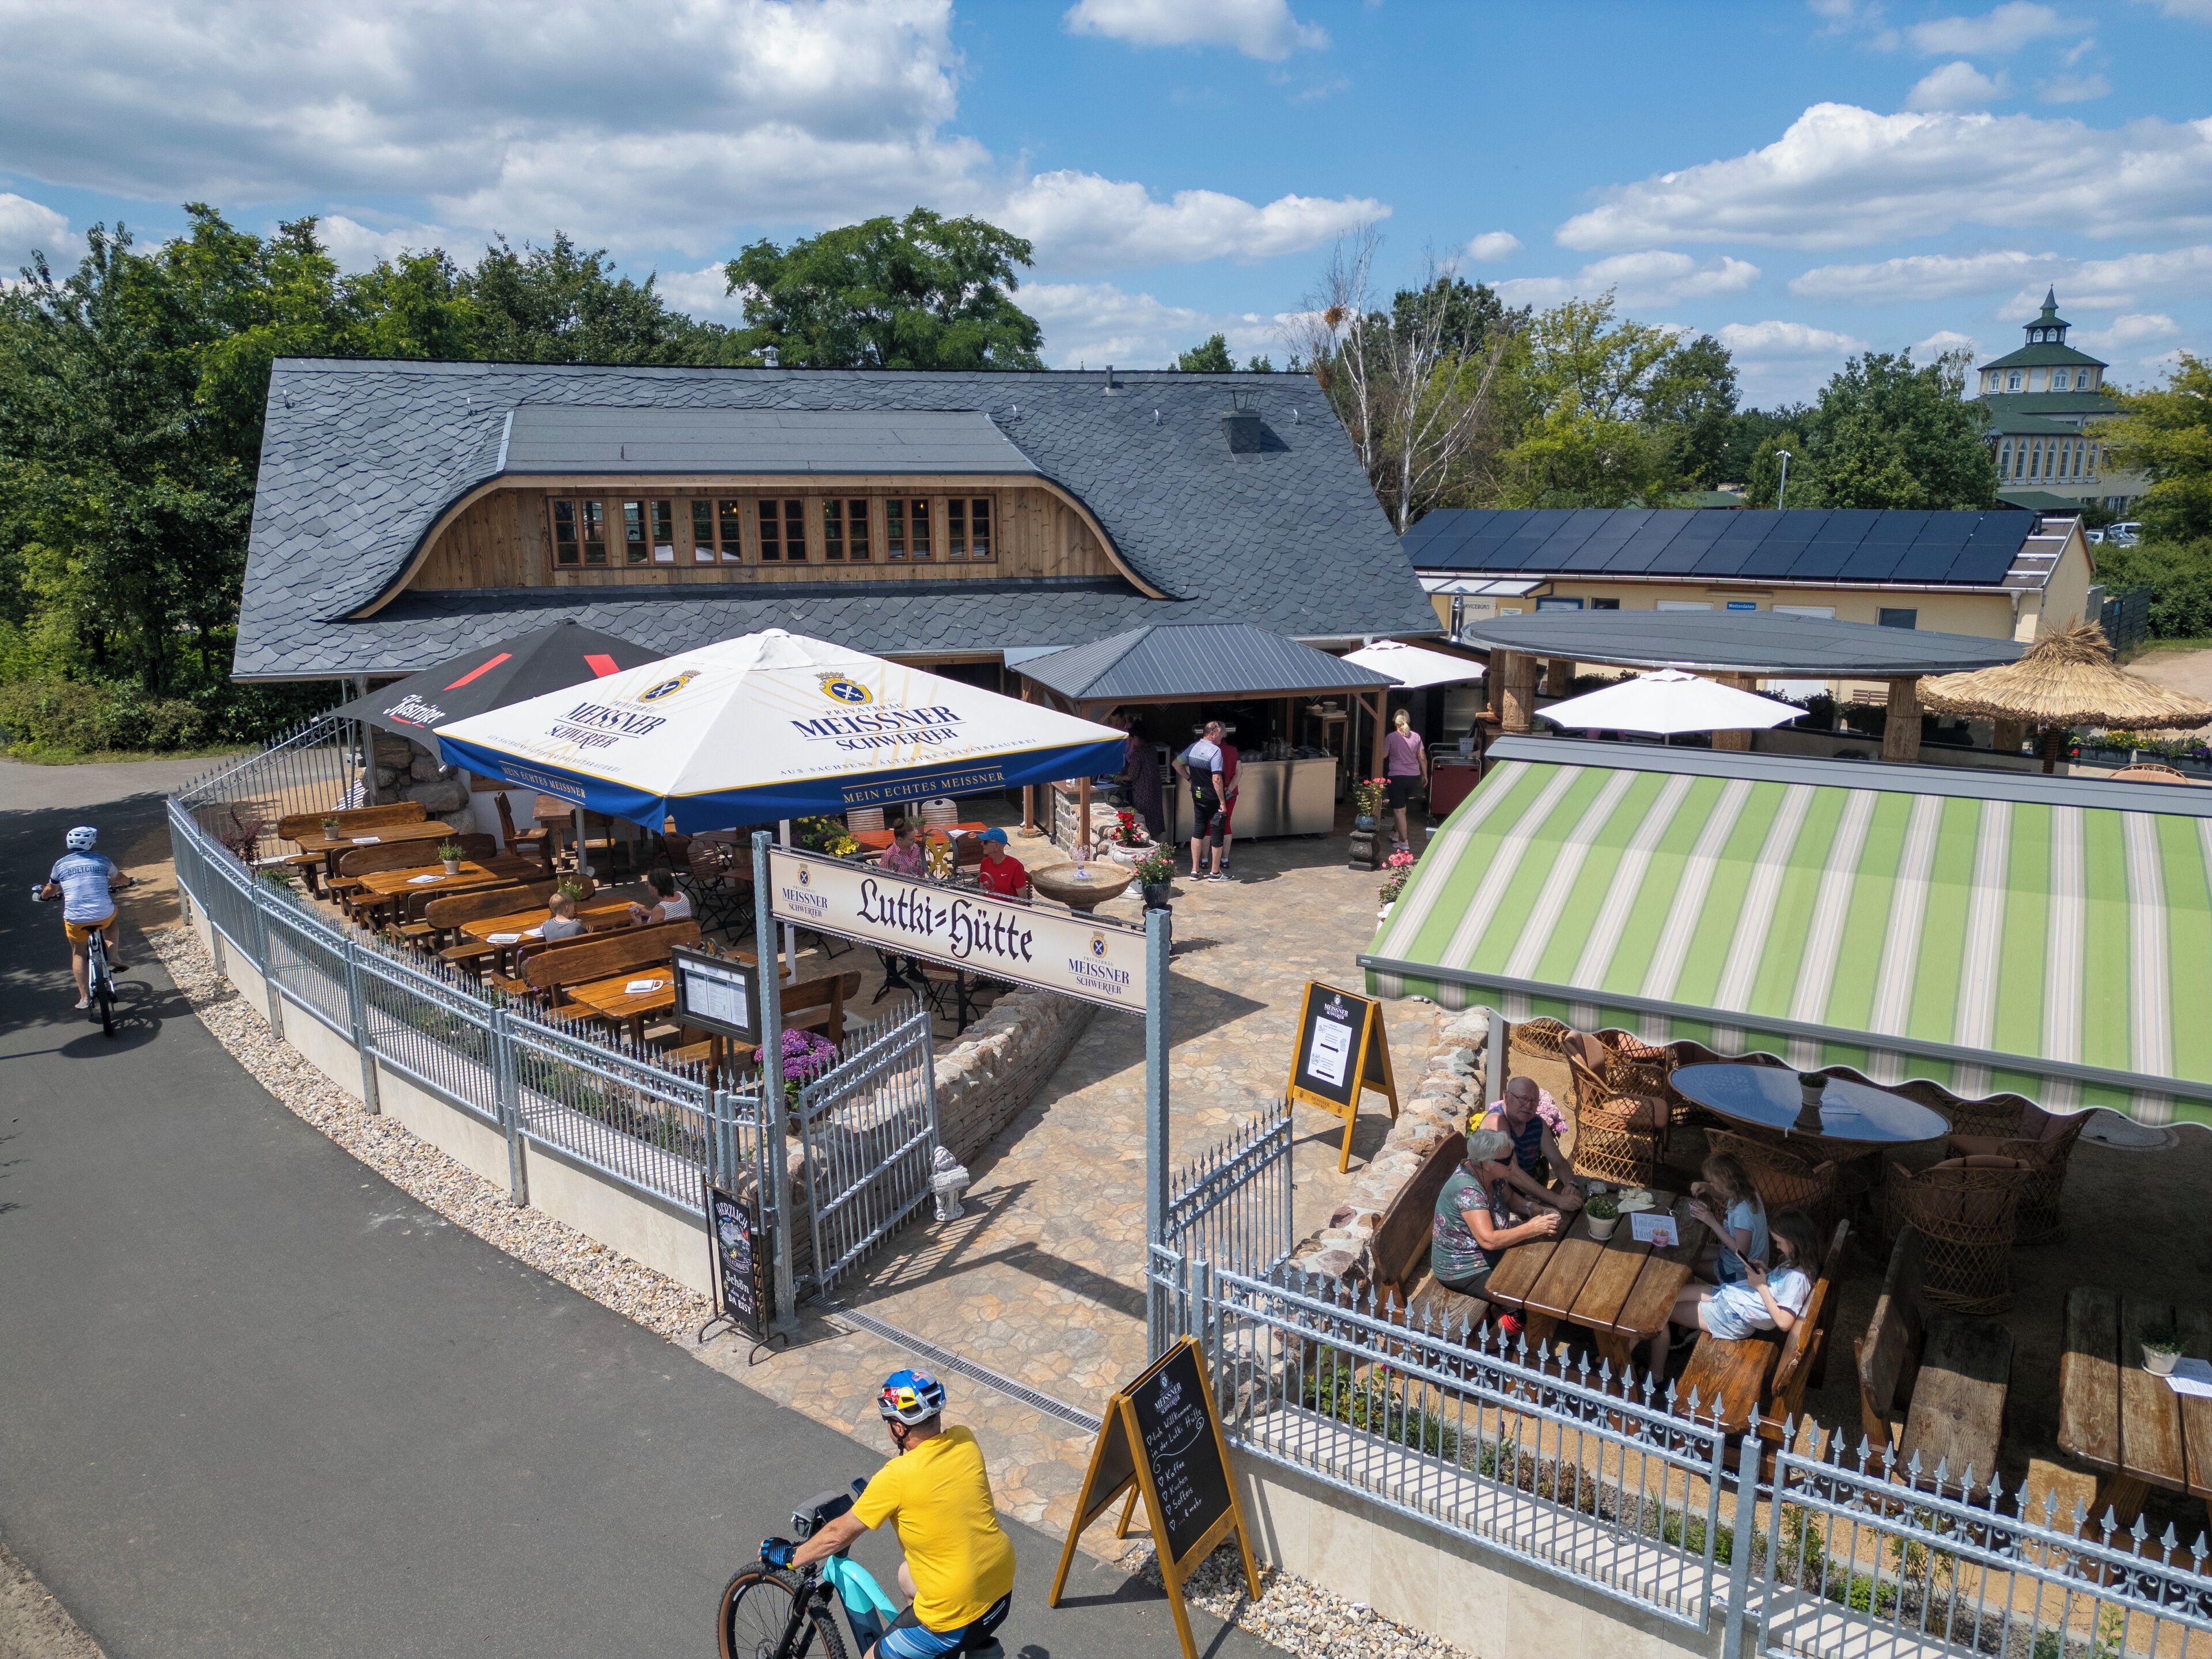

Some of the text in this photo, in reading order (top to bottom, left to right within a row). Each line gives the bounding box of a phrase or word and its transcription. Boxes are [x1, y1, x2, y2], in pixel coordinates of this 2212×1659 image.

[560, 702, 667, 736] MEISSNER
[825, 703, 904, 715] PRIVATBRÄU
[789, 706, 963, 737] MEISSNER
[546, 724, 619, 749] SCHWERTER
[836, 728, 959, 750] SCHWERTER
[809, 761, 873, 772] SACHSENS
[880, 753, 939, 765] ÄLTESTER
[944, 738, 1037, 756] PRIVATBRAUEREI
[501, 766, 585, 798] MEIN ECHTES MEISSNER
[843, 772, 1005, 804] MEIN ECHTES MEISSNER
[782, 888, 828, 909] MEISSNER
[789, 903, 822, 918] SCHWERTER
[1069, 959, 1130, 985] MEISSNER
[1076, 976, 1122, 995] SCHWERTER
[1324, 1003, 1348, 1017] MEISSNER
[715, 1203, 748, 1229] HERZLICH
[726, 1270, 749, 1294] Schön
[728, 1293, 751, 1314] DA BIST
[1154, 1382, 1181, 1410] MEISSNER
[1164, 1403, 1192, 1429] Willkommen
[1151, 1449, 1158, 1459] in
[1169, 1424, 1183, 1442] Lutki
[1165, 1461, 1185, 1481] Kaffee
[1169, 1475, 1188, 1495] Kuchen
[1173, 1487, 1193, 1509] Softeis
[1190, 1498, 1202, 1513] mehr
